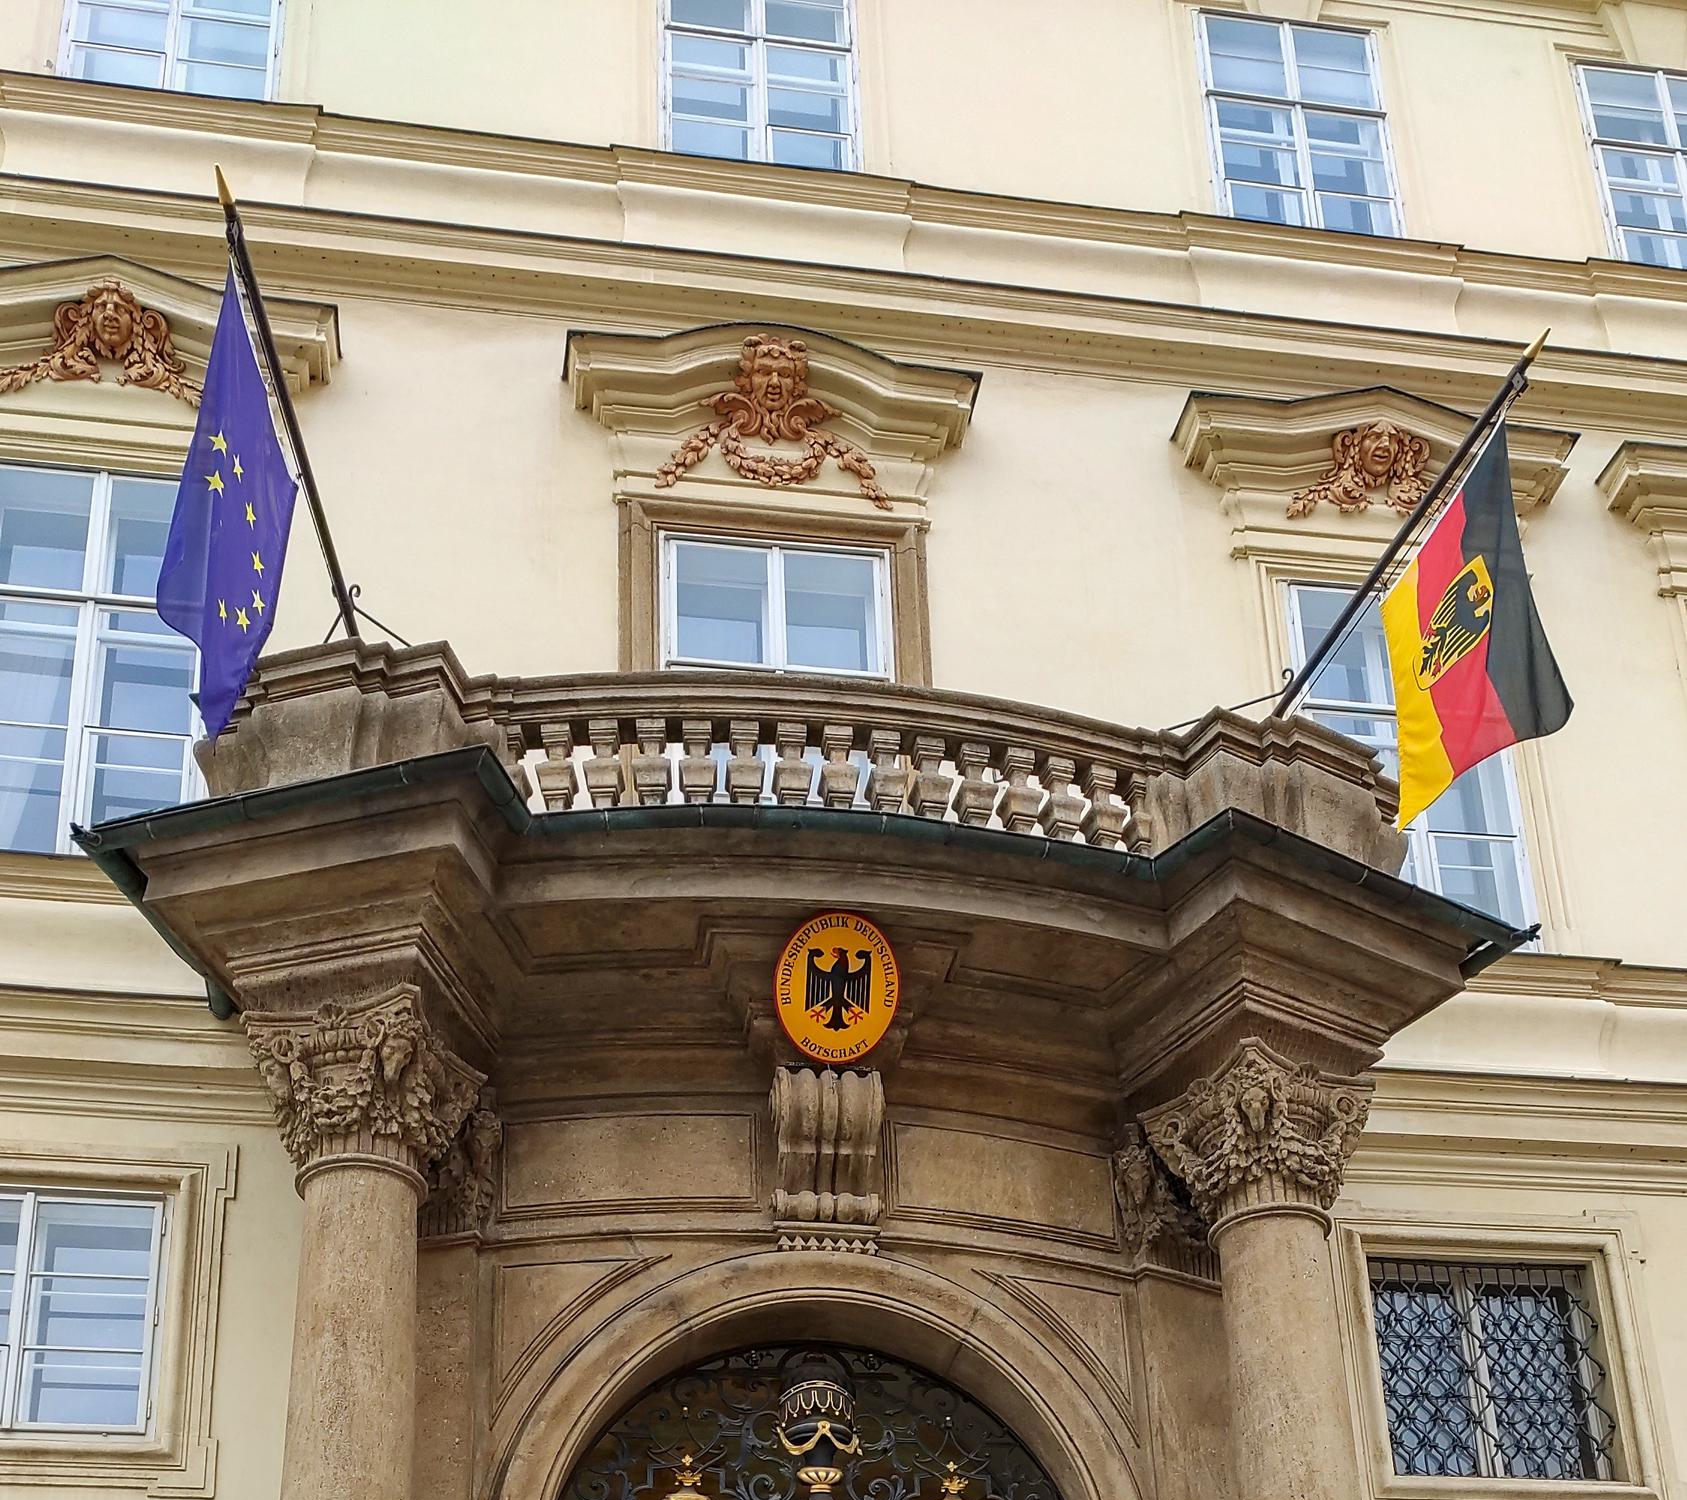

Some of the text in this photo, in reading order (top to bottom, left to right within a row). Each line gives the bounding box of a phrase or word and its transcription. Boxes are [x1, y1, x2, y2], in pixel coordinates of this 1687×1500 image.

[780, 915, 896, 1008] BUNDESREPUBLIK DEUTSCHLAND
[800, 1036, 869, 1059] BOTSCHAFT
